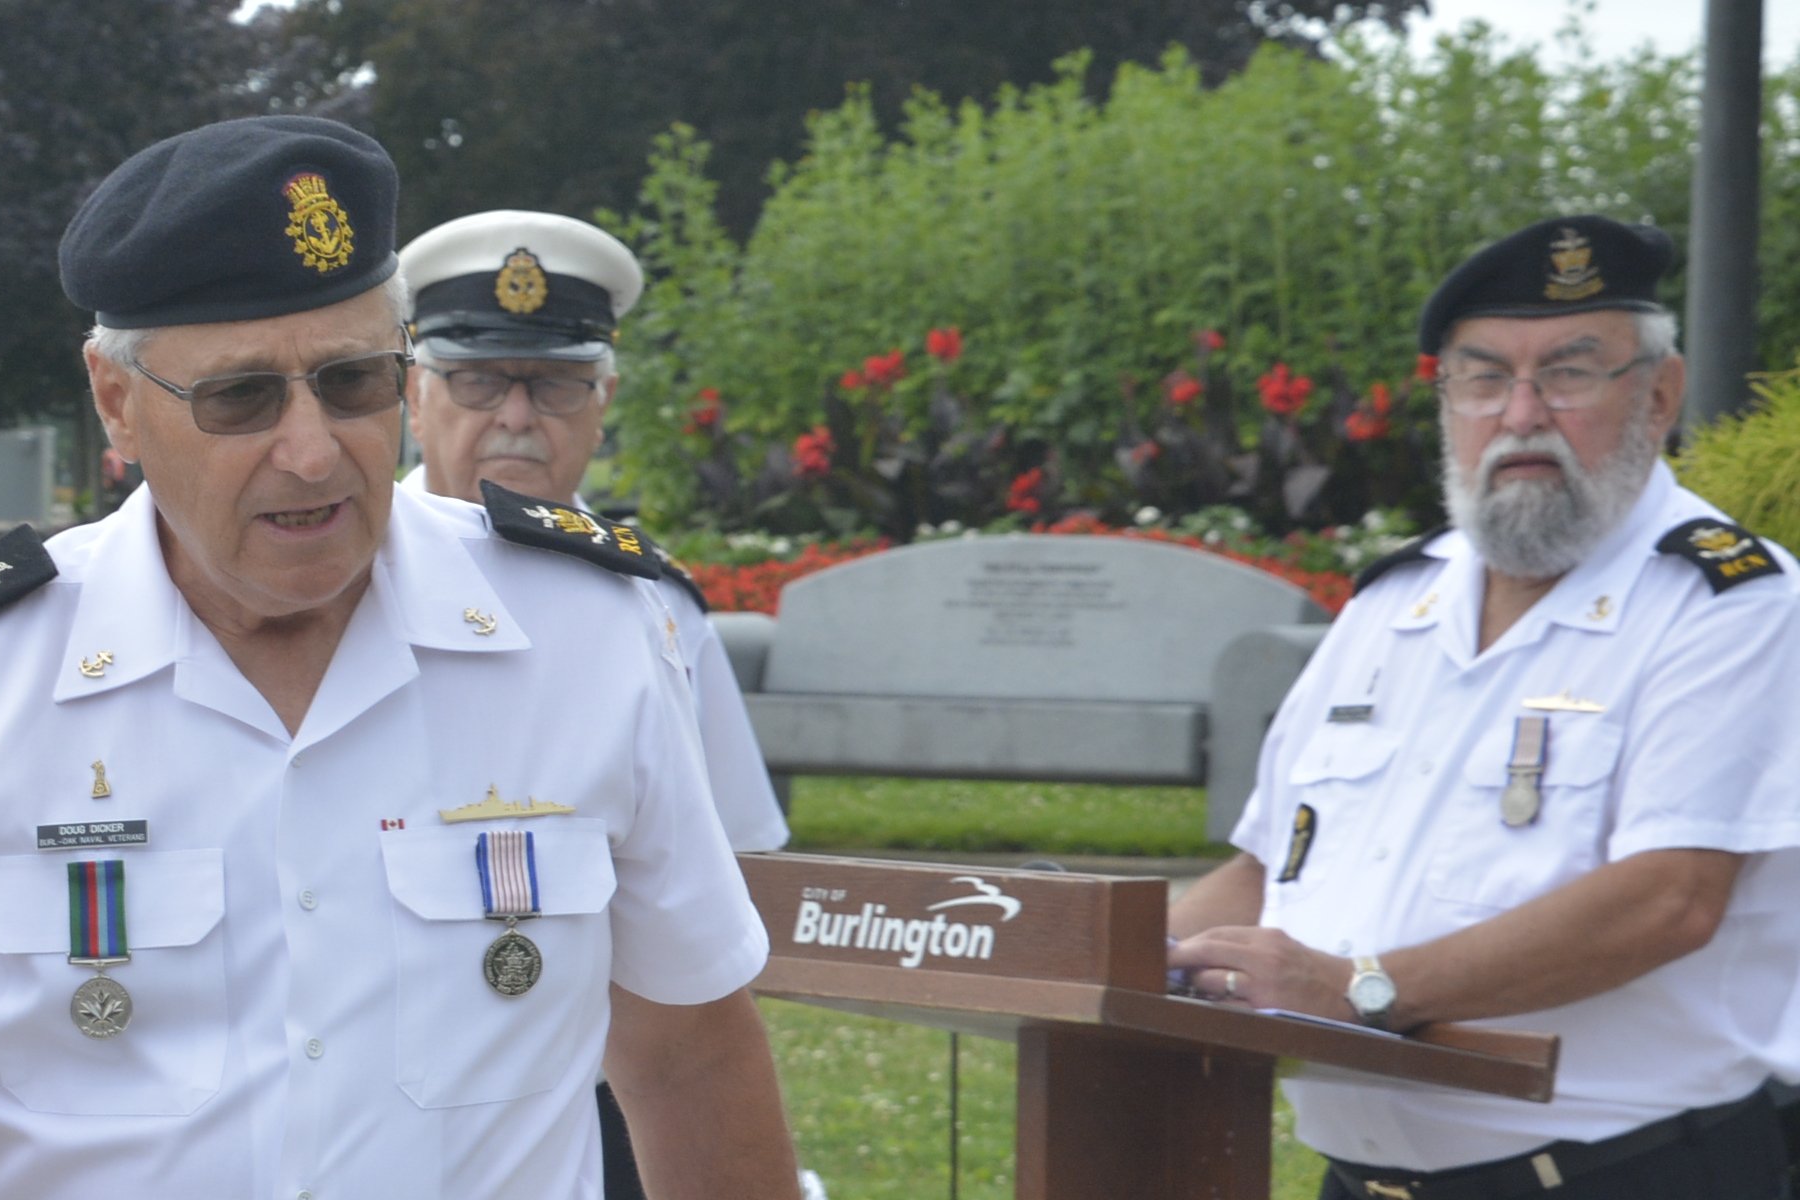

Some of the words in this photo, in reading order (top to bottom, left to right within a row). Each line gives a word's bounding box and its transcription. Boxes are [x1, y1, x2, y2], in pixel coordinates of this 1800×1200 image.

[611, 526, 643, 556] RCN
[58, 825, 86, 836] DOUG
[80, 835, 104, 845] NAVAL
[107, 833, 146, 843] VETERANS
[802, 887, 826, 900] CITY
[830, 888, 848, 902] OF
[793, 900, 996, 968] Burlington
